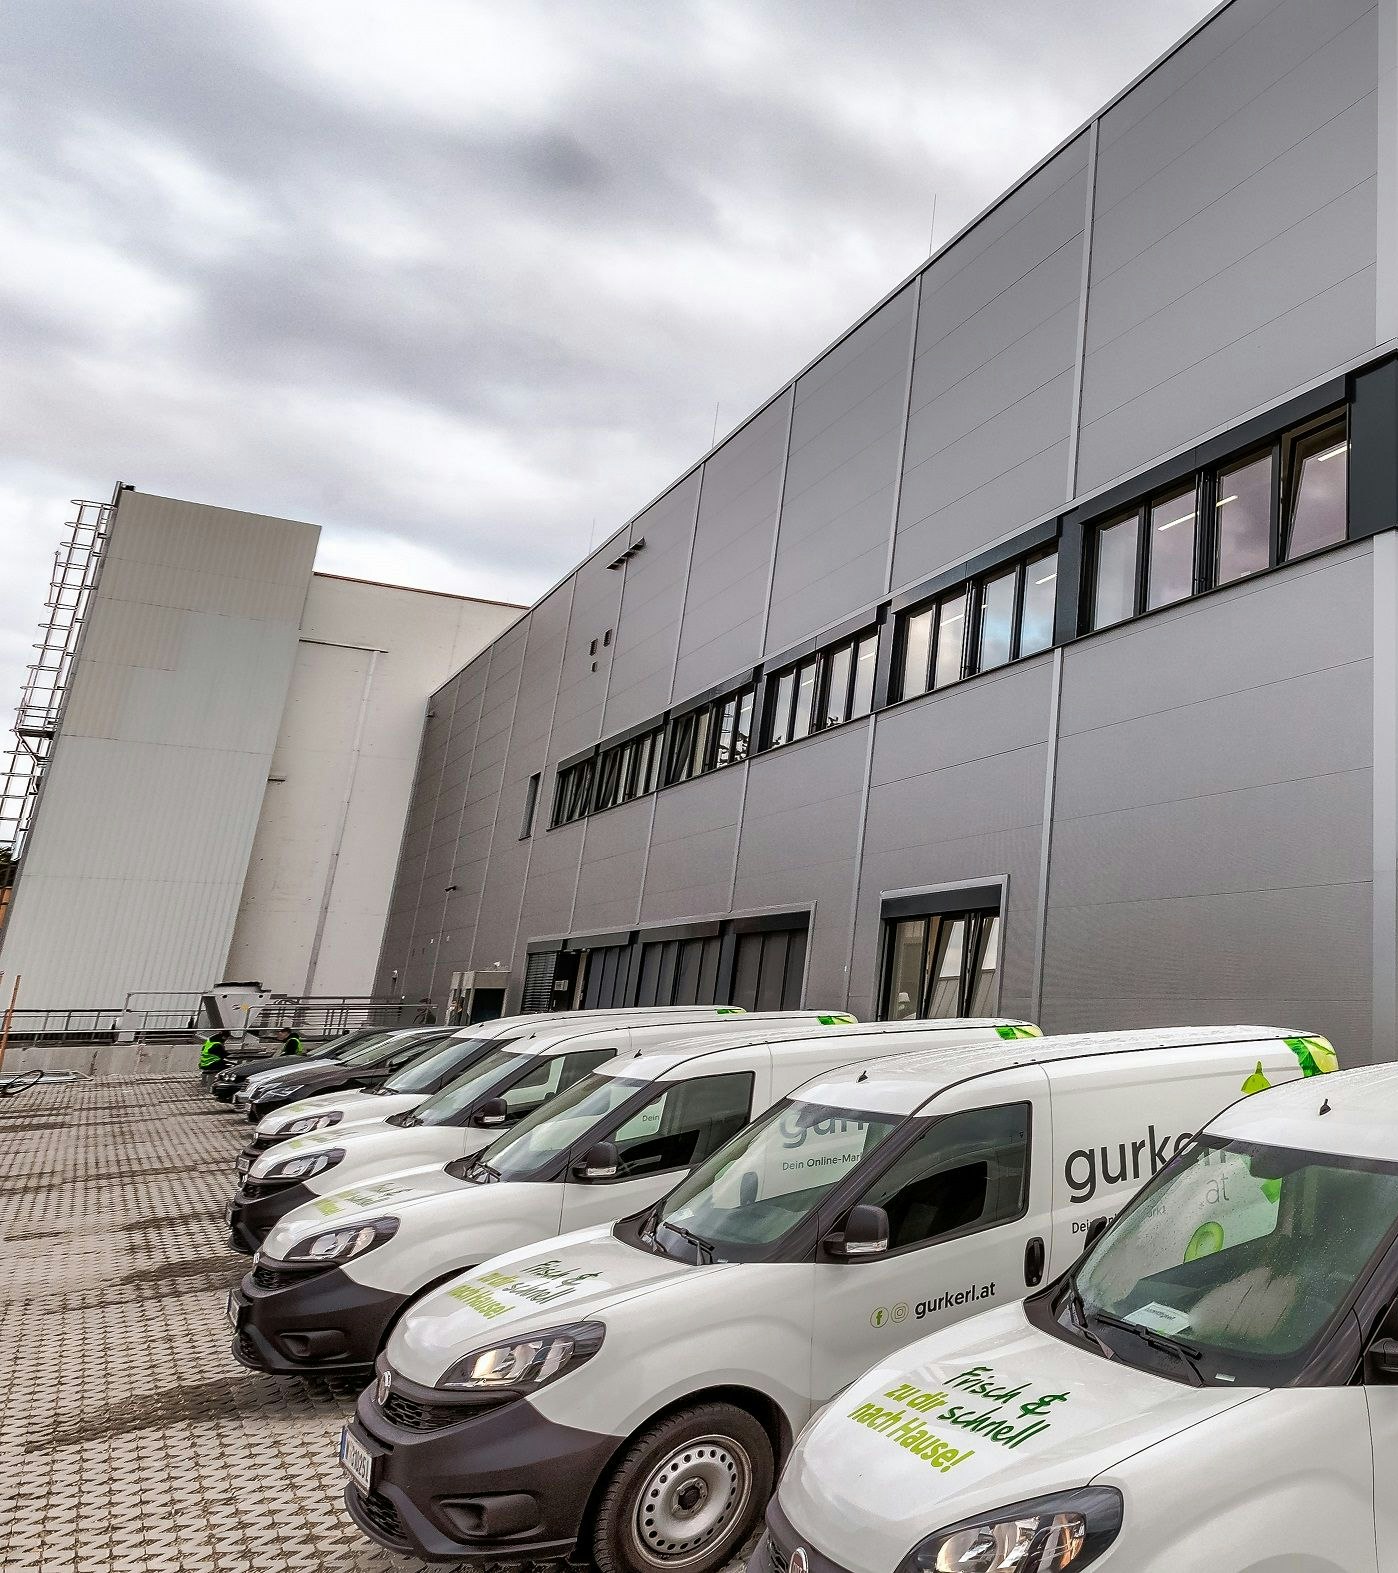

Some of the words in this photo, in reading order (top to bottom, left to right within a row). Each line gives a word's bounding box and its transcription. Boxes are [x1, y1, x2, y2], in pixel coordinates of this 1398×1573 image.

[782, 1161, 804, 1171] Dein
[806, 1154, 860, 1167] Online-Mar
[1065, 1125, 1226, 1203] gurke
[1072, 1218, 1090, 1234] Dei
[915, 1282, 996, 1319] gurkerl.at
[941, 1366, 1033, 1404] Frisch
[1016, 1391, 1071, 1419] &
[847, 1402, 907, 1433] nach
[885, 1417, 975, 1473] Hause!
[937, 1406, 1051, 1449] schnell
